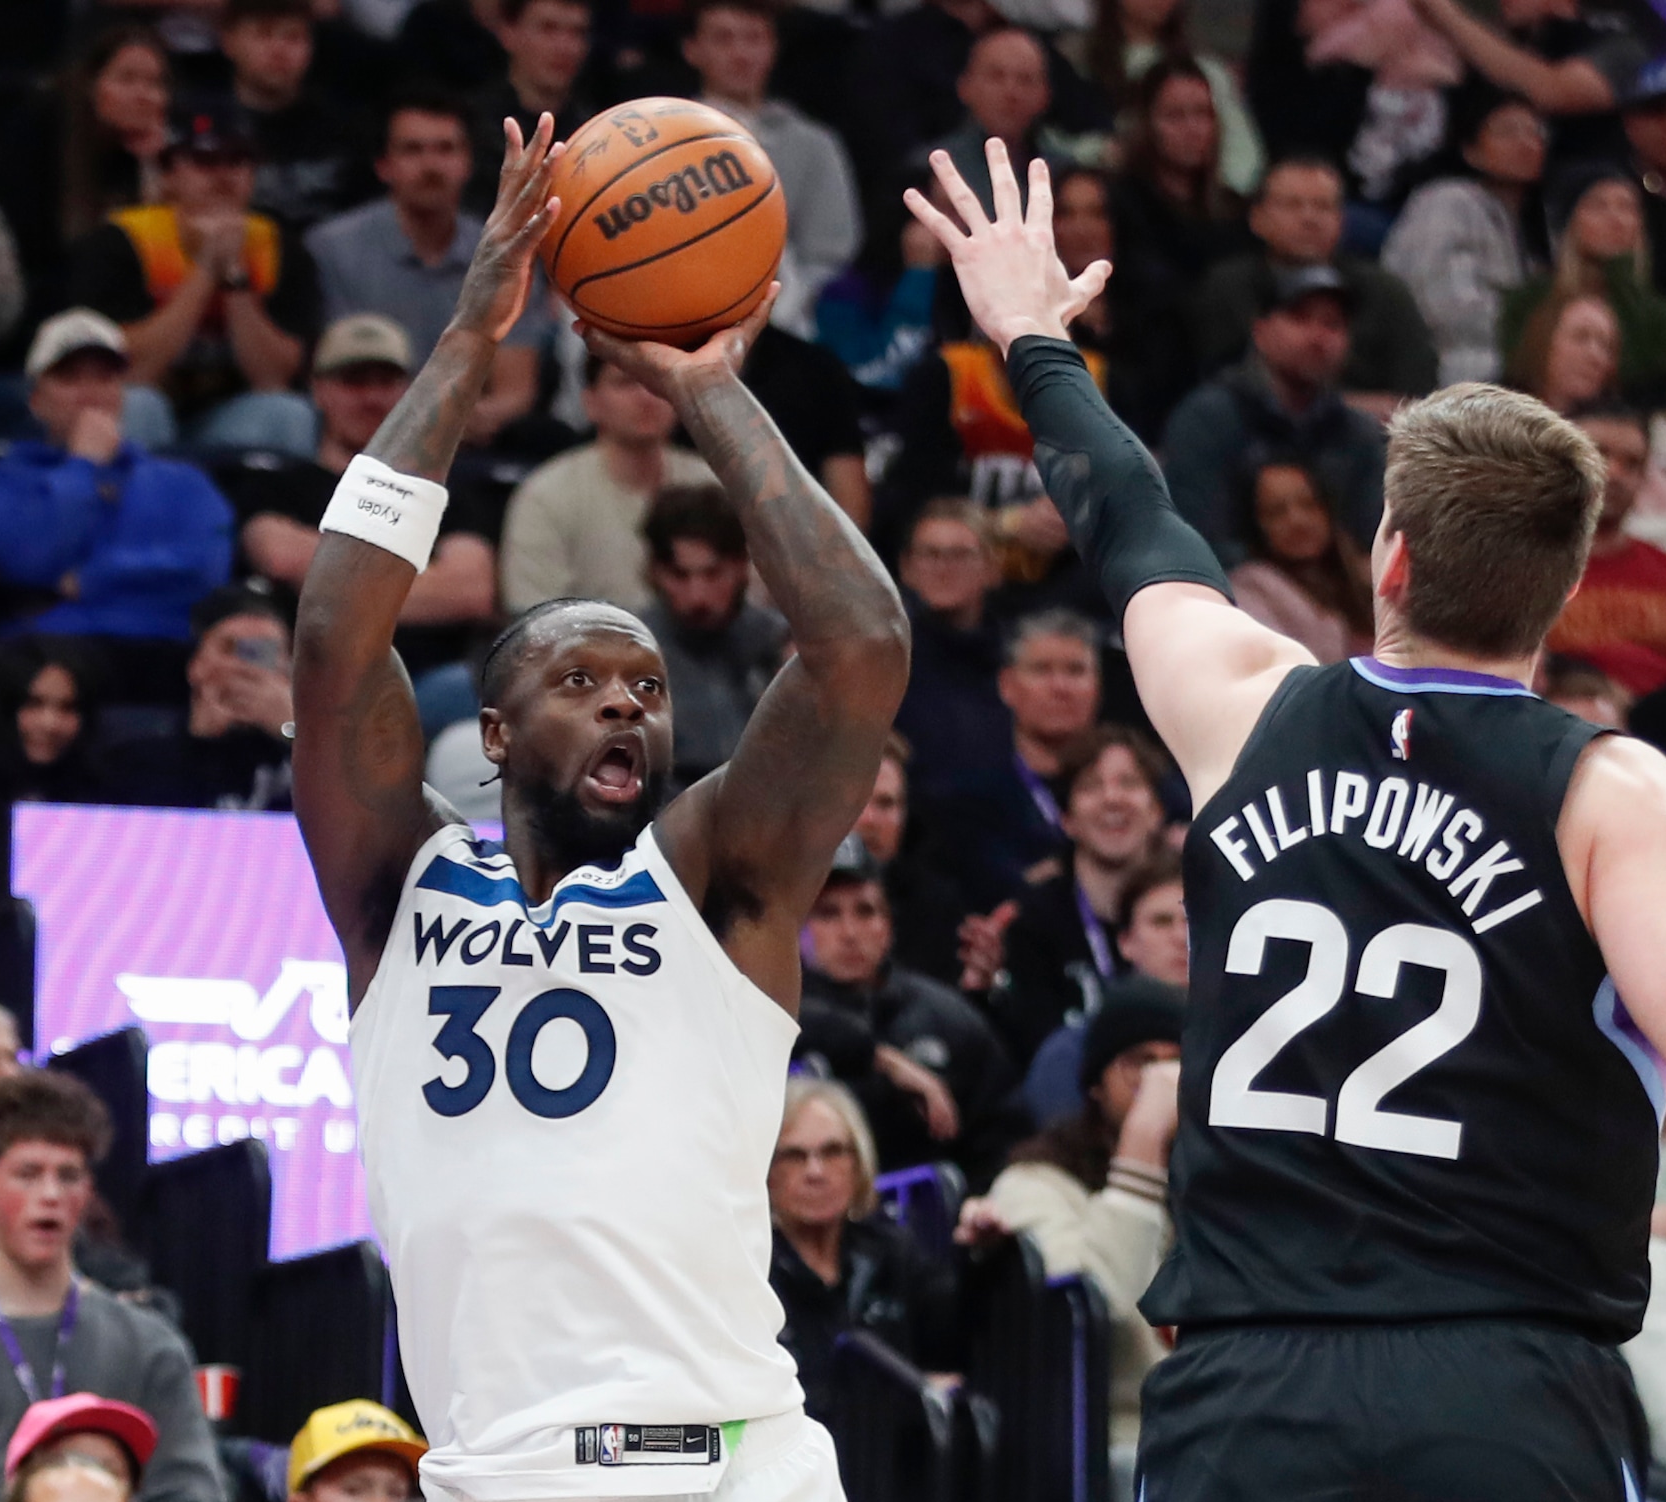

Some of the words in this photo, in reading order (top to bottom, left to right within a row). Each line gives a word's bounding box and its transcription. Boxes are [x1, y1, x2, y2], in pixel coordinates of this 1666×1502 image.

[593, 150, 754, 241] Wilson
[1209, 768, 1544, 935] FILIPOWSKI
[414, 911, 662, 977] WOLVES
[421, 985, 617, 1120] 30
[1208, 898, 1483, 1161] 22
